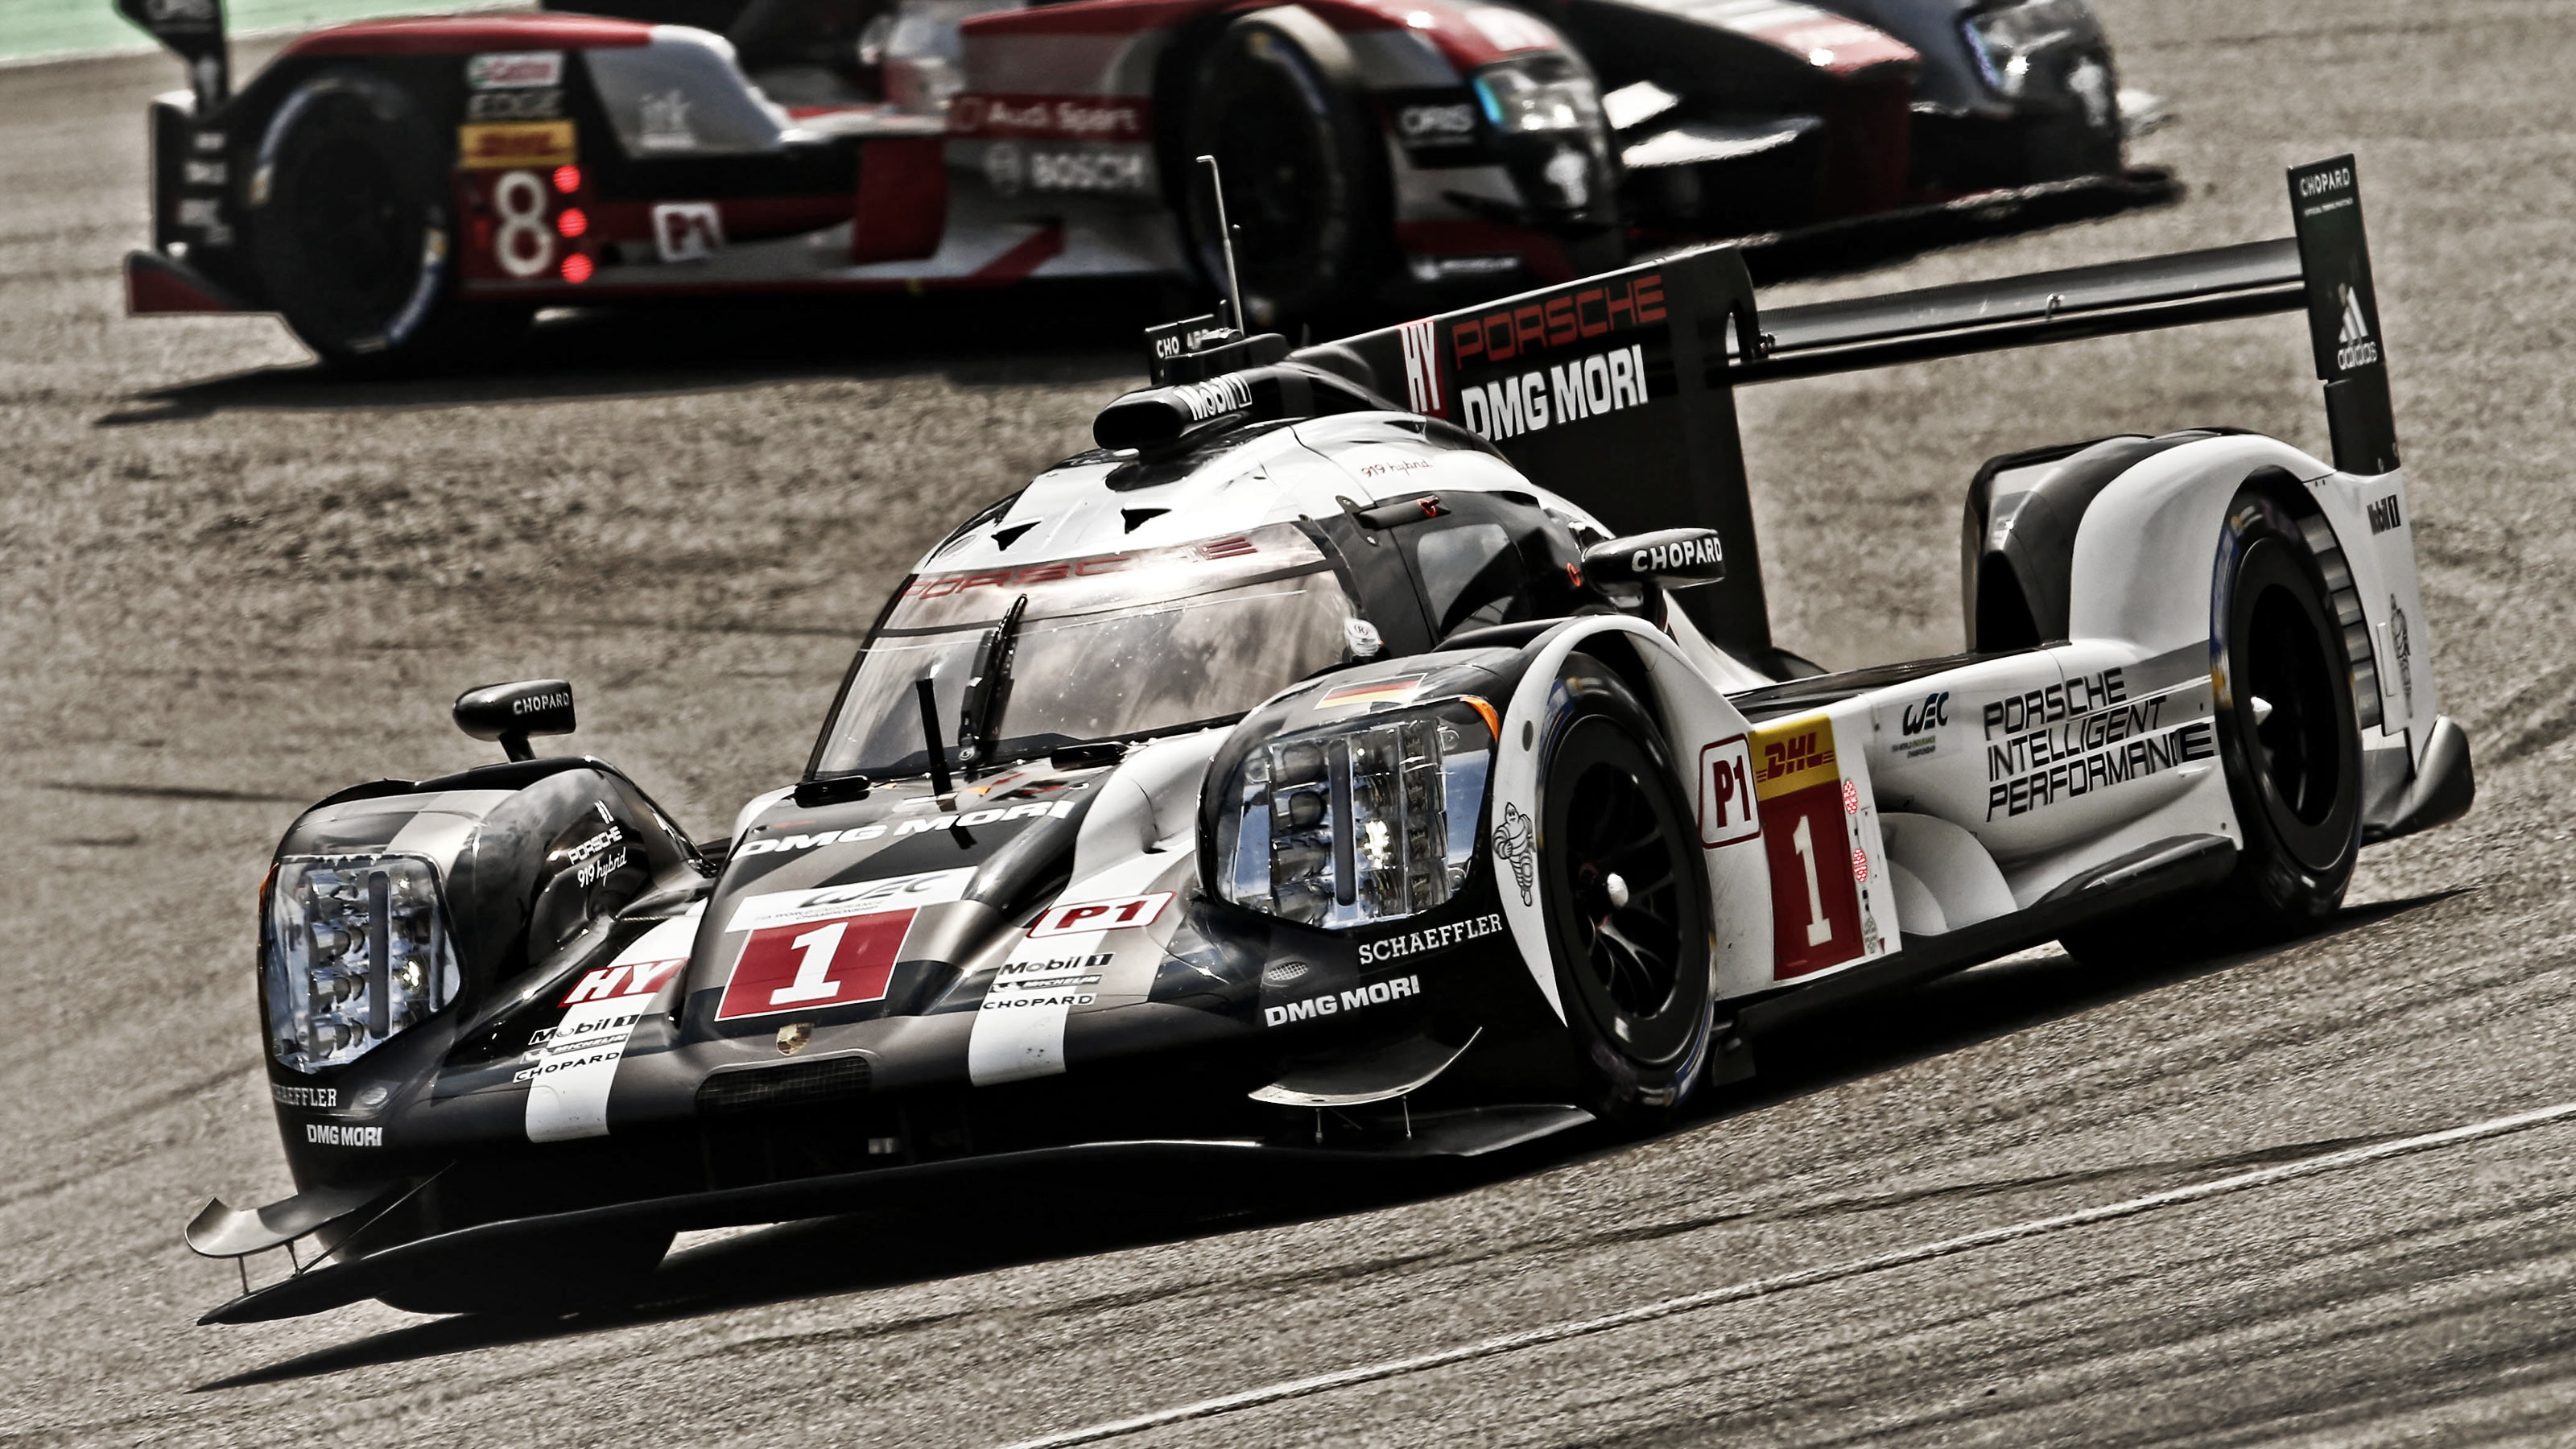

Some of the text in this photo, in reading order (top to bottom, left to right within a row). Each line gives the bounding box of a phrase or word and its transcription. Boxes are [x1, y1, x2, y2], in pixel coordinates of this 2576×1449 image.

[1031, 151, 1143, 189] BOSCH
[2299, 167, 2351, 197] CHOPARD
[493, 171, 554, 275] 8
[1451, 275, 1667, 370] PORSCHE
[1401, 320, 1441, 413] HY
[2338, 338, 2378, 371] adidas
[1461, 344, 1649, 442] DMG MORI
[1360, 463, 1385, 477] 919
[900, 536, 1258, 601] PORSCE
[1631, 537, 1723, 572] CHOPARD
[513, 692, 570, 715] CHOPARD
[1902, 691, 1950, 737] WEC
[1983, 667, 2128, 741] PORSCHE
[1764, 731, 1825, 781] DHL
[1987, 695, 2167, 782] INTELLIGENT
[1712, 754, 1752, 828] P1
[568, 825, 623, 865] PORSCHE
[730, 799, 1076, 861] DMG MORI
[577, 846, 627, 888] 919 hybrid
[1792, 815, 1833, 947] 1
[1055, 899, 1150, 930] P1
[1358, 913, 1503, 965] SCHAEFFLER
[563, 959, 683, 1004] HY
[769, 921, 849, 1005] 1
[998, 956, 1083, 975] Mobil
[983, 995, 1093, 1010] CHOPARD
[1264, 974, 1421, 1027] DMG MORI
[530, 1018, 612, 1044] Mobil
[516, 1052, 620, 1080] CHOPARD
[306, 1124, 383, 1146] DMG MORI
